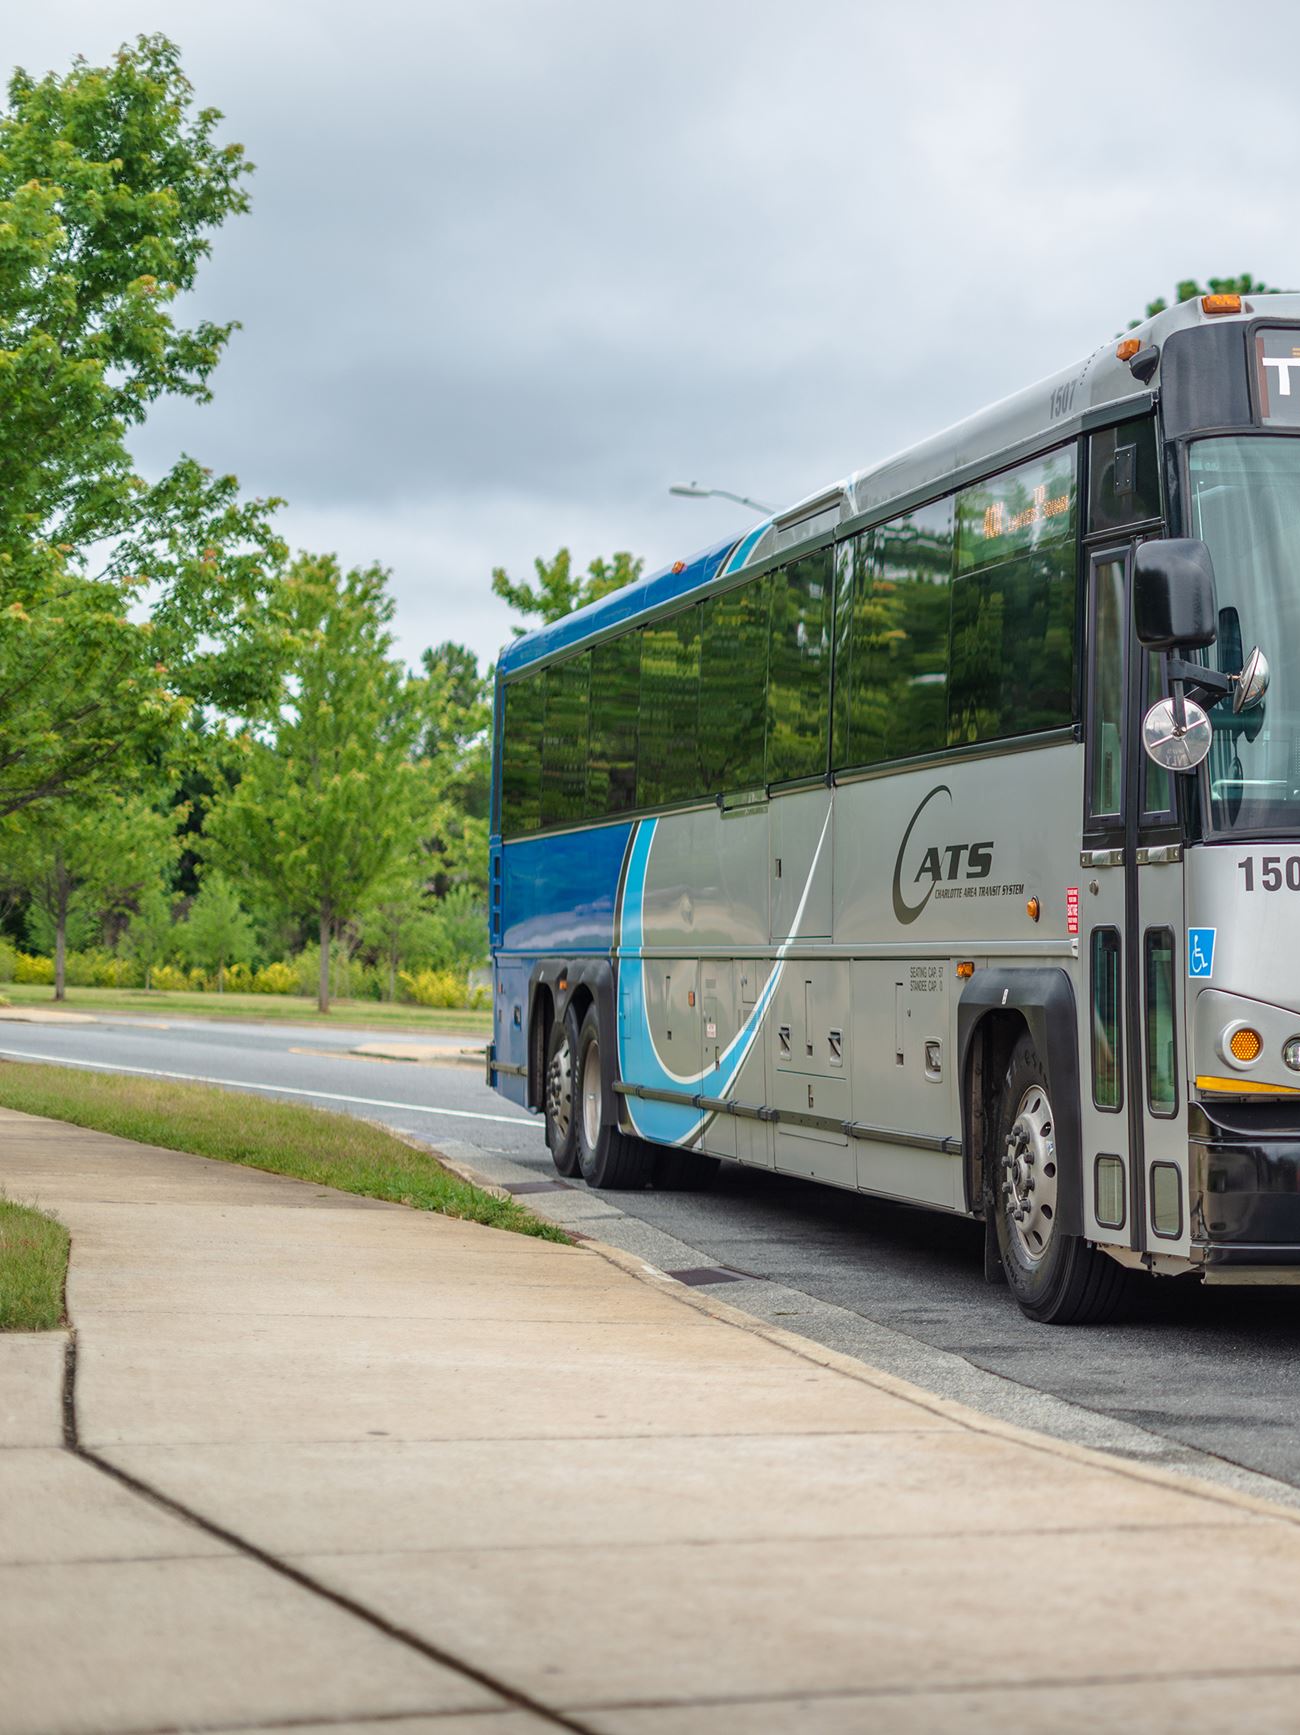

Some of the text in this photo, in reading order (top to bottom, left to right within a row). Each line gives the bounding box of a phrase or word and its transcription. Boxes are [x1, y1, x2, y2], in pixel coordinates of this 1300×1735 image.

[1050, 379, 1078, 420] 1507
[935, 883, 1025, 899] CHARLOTTE AREA TRANSIT SYSTEM
